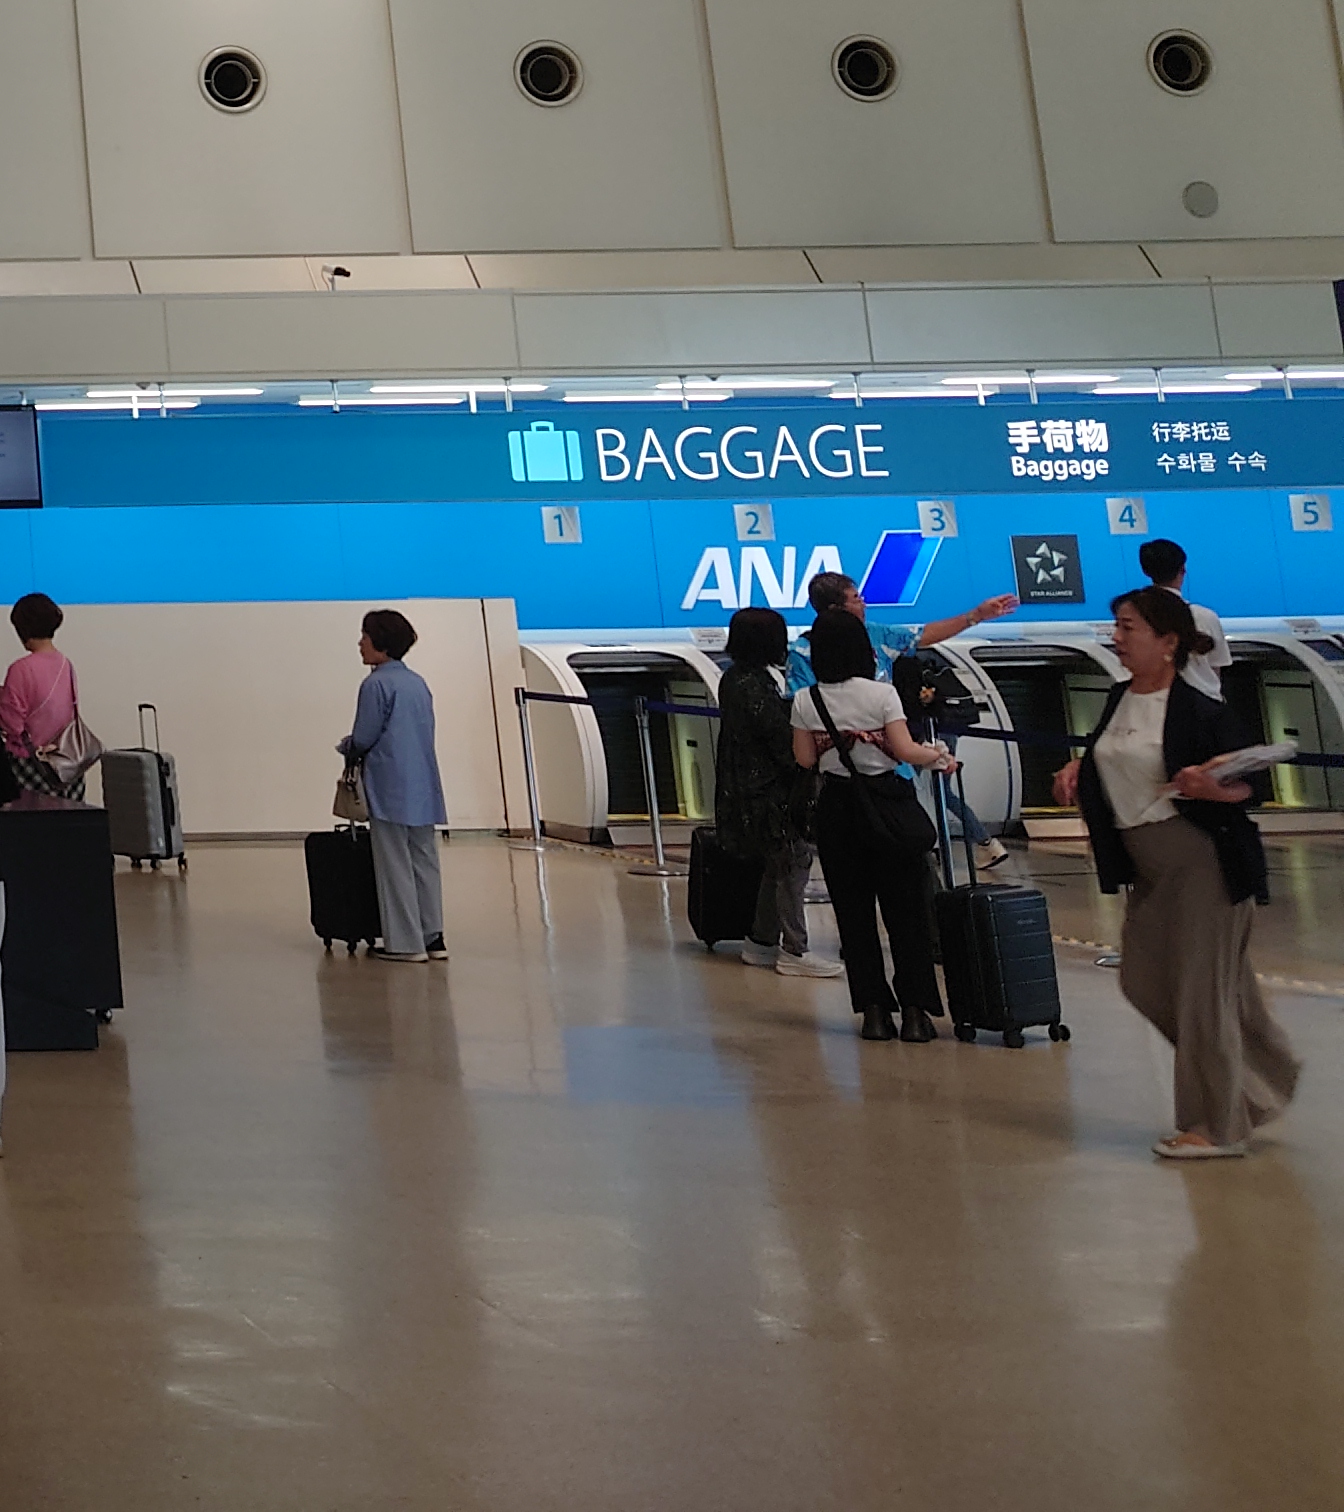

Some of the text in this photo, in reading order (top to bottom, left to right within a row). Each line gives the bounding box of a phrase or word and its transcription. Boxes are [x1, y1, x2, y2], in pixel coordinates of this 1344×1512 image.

[1007, 420, 1109, 453] 手荷物
[1152, 421, 1231, 443] 行李托运
[595, 424, 889, 481] BAGGAGE
[1156, 451, 1268, 474] 수화물 수속
[1011, 455, 1109, 481] Baggage
[746, 511, 762, 534] 2
[931, 508, 946, 531] 3
[1119, 505, 1137, 528] 4
[1303, 501, 1319, 525] 5
[553, 514, 564, 537] 1
